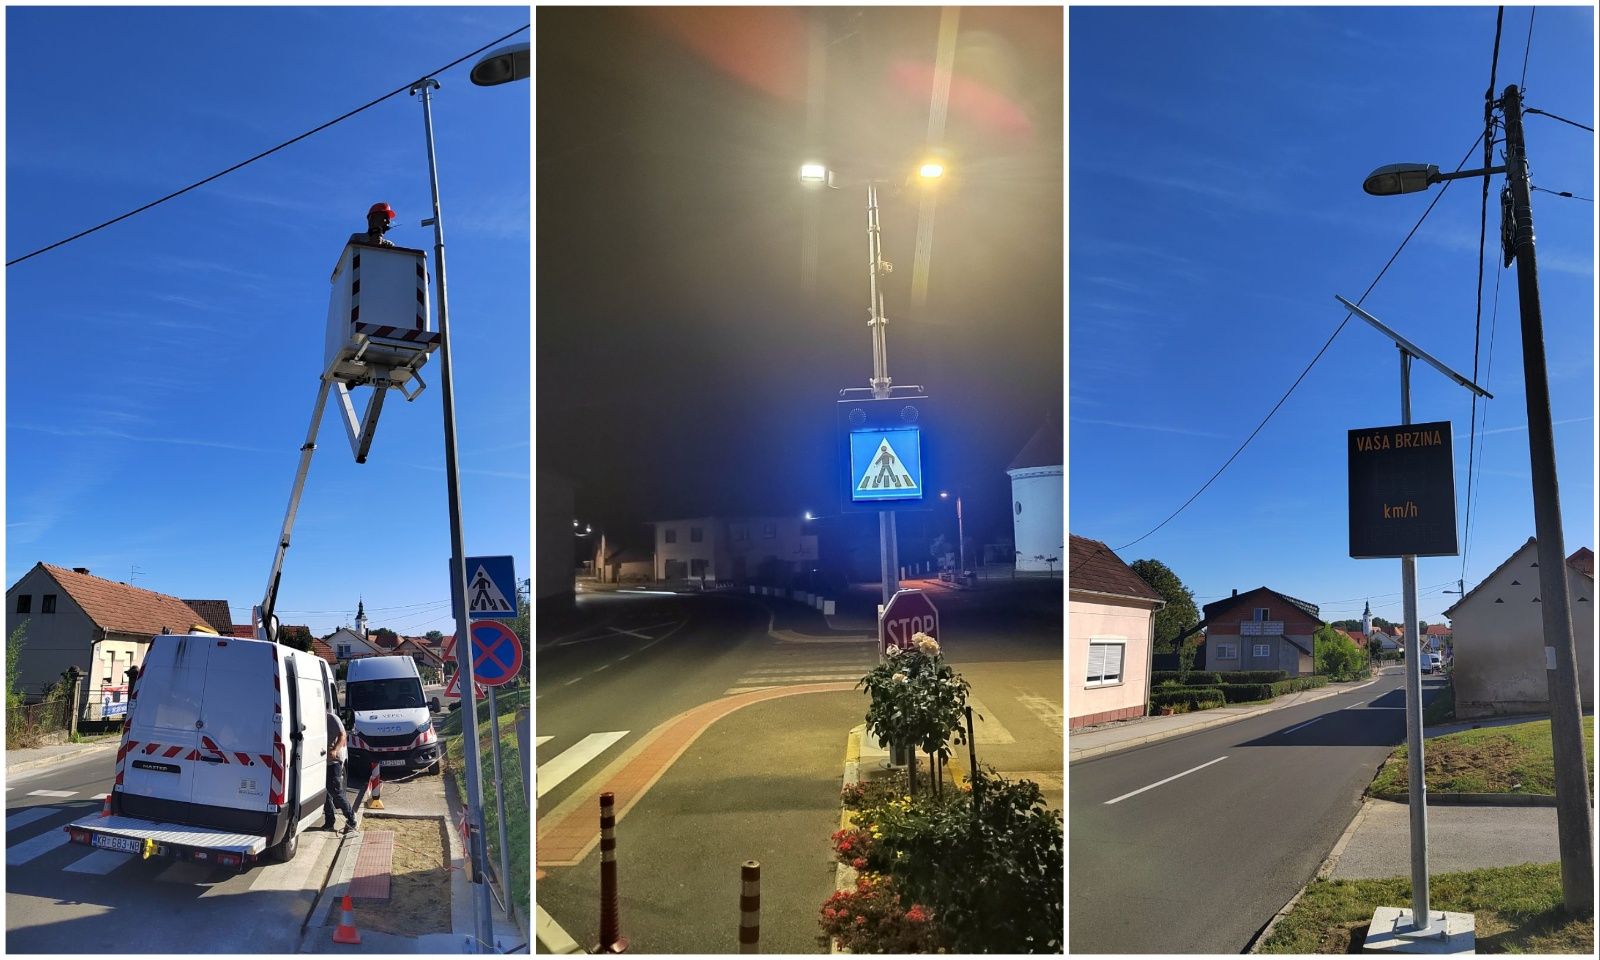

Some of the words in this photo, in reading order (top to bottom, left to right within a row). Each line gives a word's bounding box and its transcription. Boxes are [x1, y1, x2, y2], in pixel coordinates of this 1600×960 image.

[1356, 431, 1390, 452] VAŠA
[1395, 430, 1442, 448] BRZINA
[1384, 501, 1418, 519] km/h
